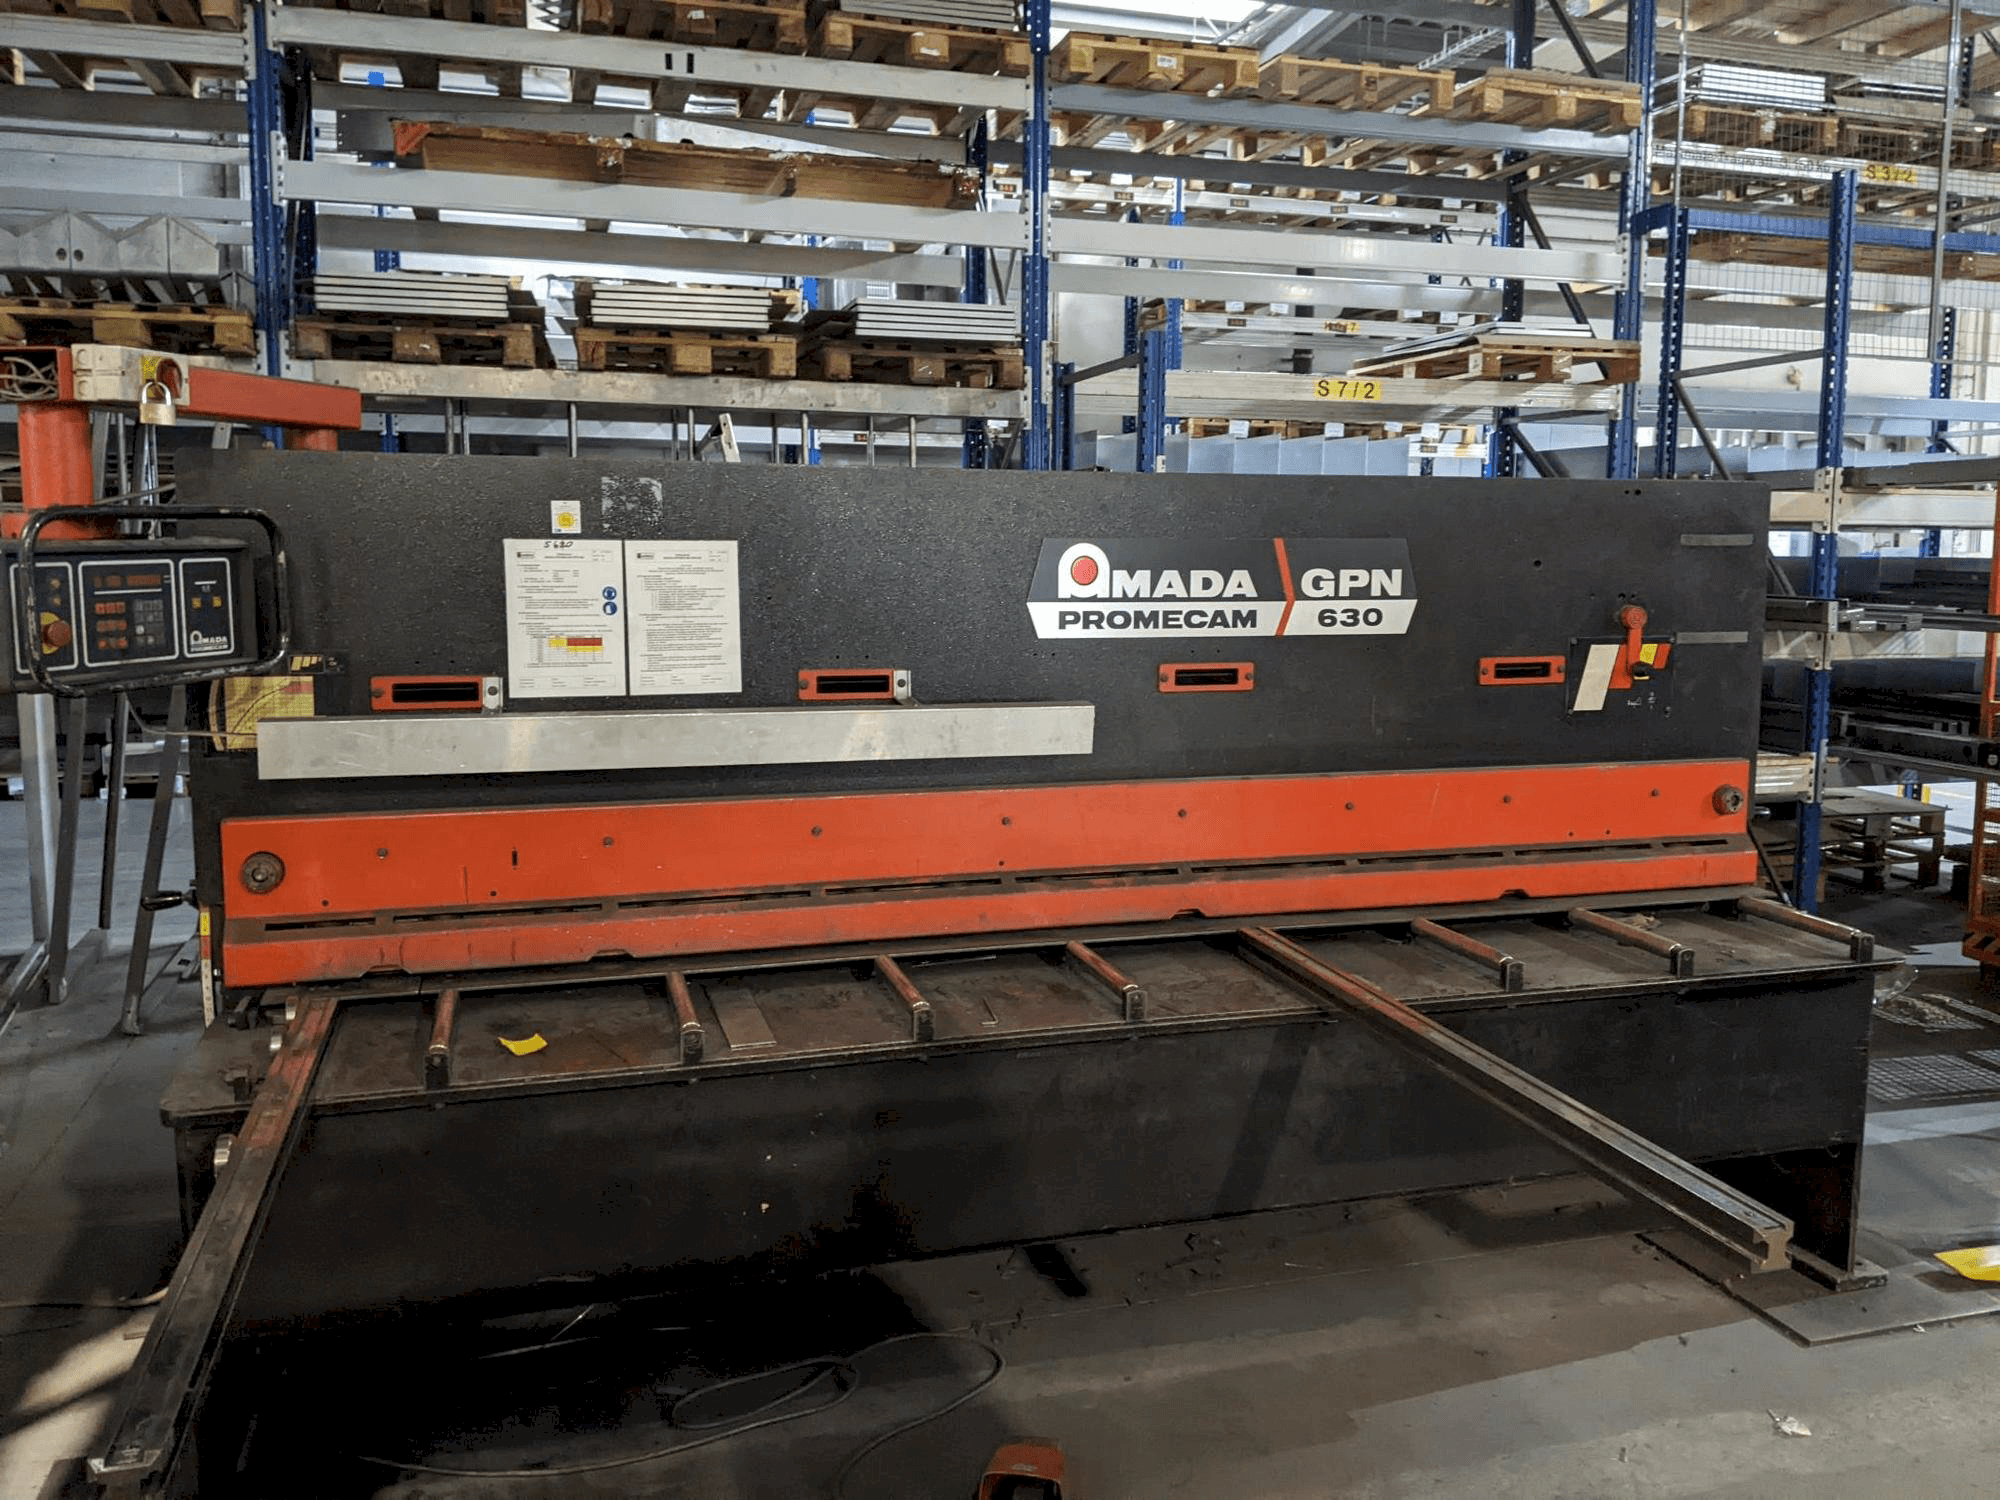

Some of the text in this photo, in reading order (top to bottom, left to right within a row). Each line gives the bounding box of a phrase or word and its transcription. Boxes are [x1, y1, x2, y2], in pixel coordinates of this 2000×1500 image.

[1865, 163, 1876, 180] S
[1317, 379, 1330, 397] S
[1058, 542, 1403, 599] AMADA GPN
[1058, 607, 1384, 630] PROMECAM 630
